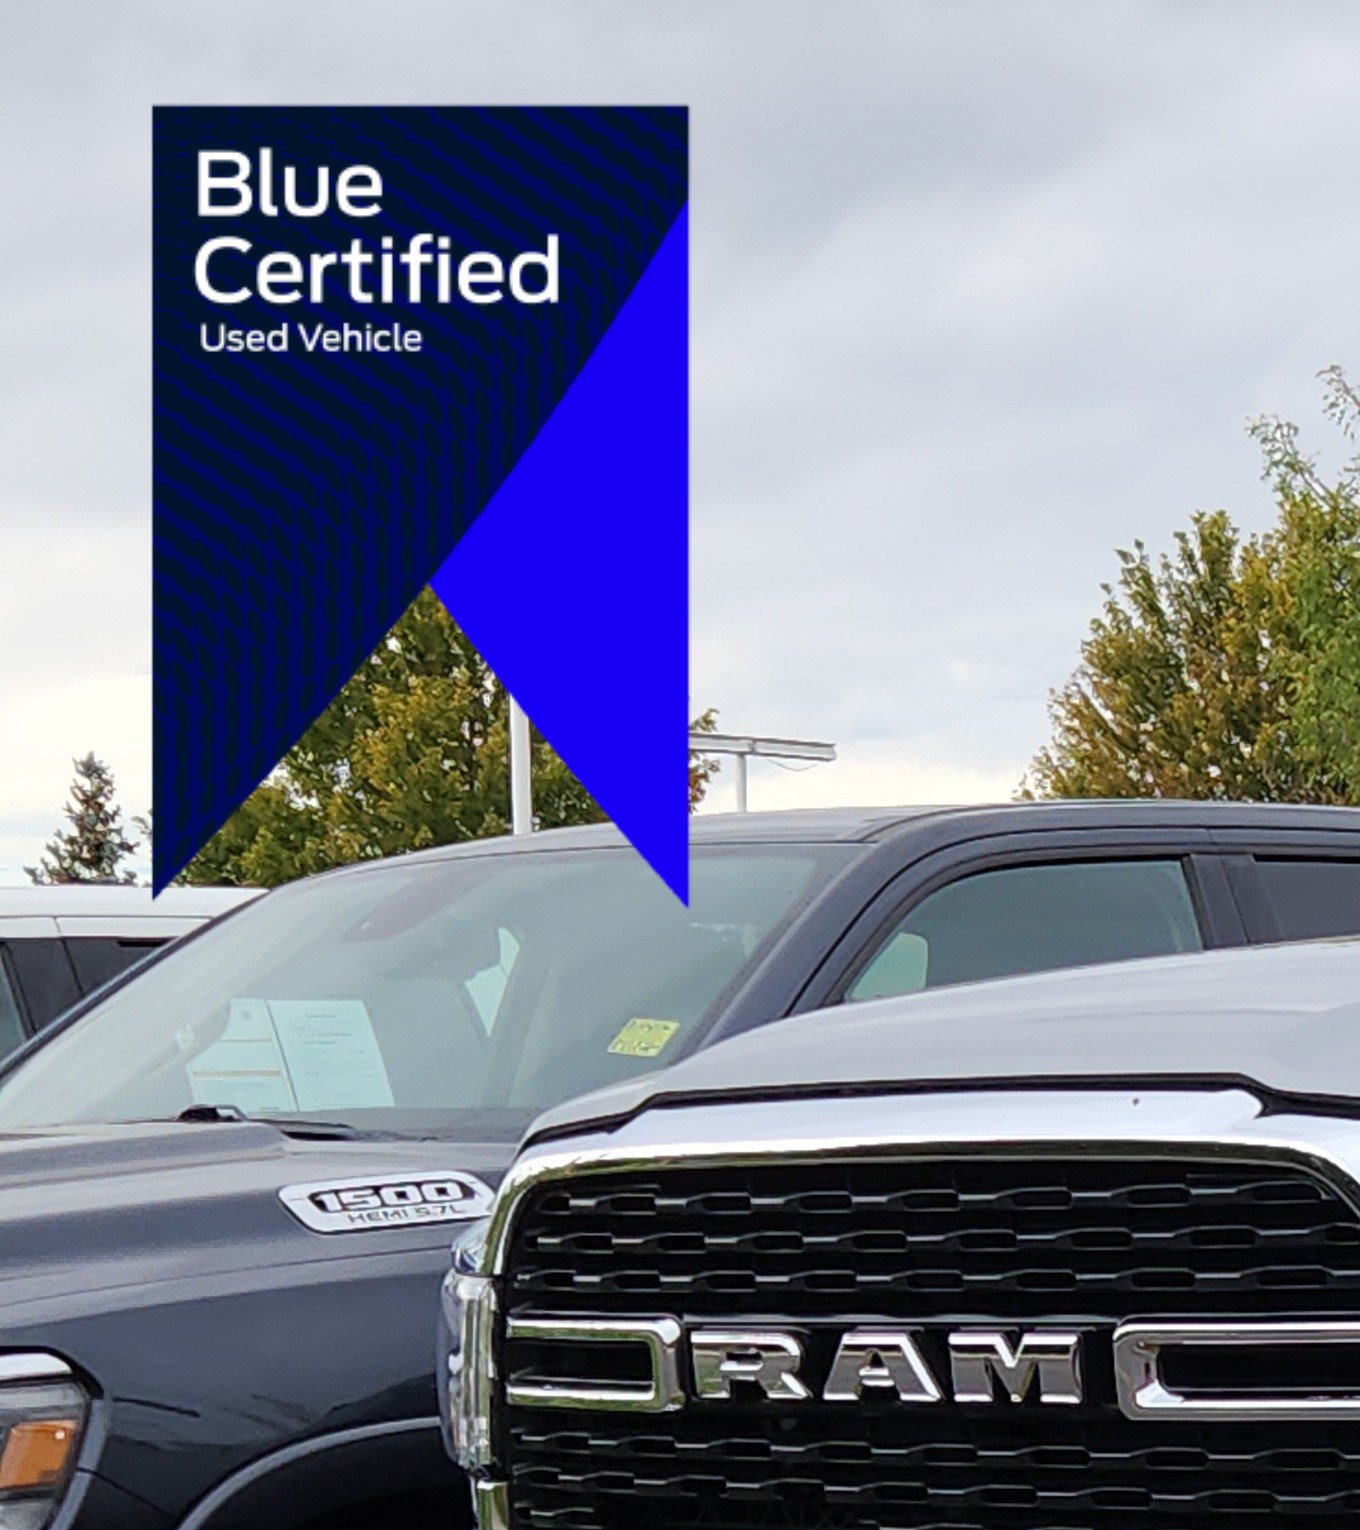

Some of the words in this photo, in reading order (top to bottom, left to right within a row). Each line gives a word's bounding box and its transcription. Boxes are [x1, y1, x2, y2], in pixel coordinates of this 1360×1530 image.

[313, 1181, 464, 1212] 1500
[347, 1210, 409, 1225] HEMI
[690, 1331, 1083, 1404] RAM
